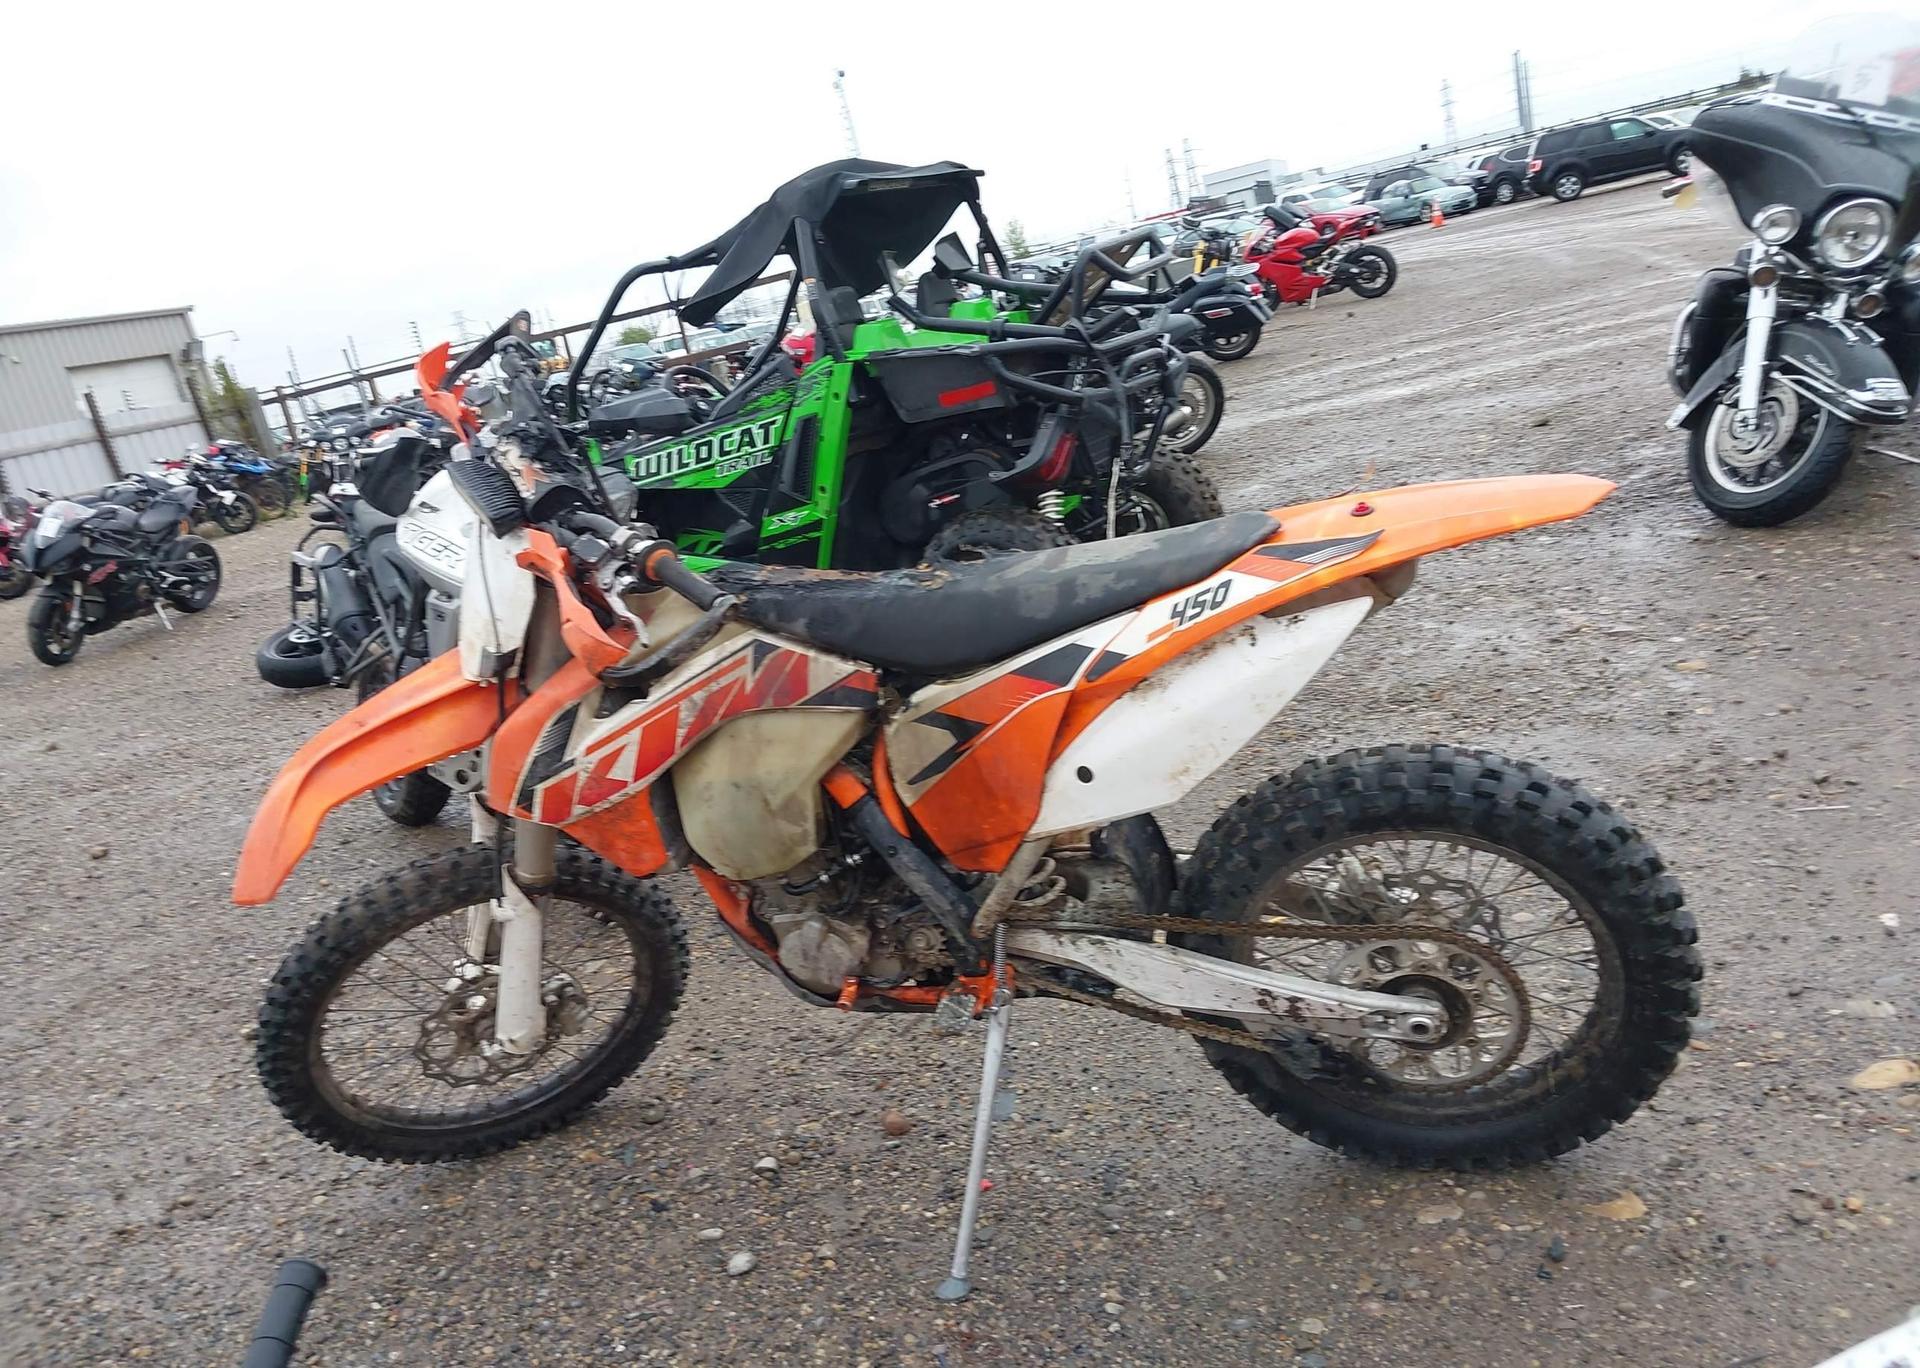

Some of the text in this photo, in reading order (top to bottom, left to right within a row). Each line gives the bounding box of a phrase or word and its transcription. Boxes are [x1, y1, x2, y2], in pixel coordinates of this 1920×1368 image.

[630, 414, 785, 480] WILDCAT
[715, 451, 775, 479] TRAIL
[1170, 578, 1233, 628] 450
